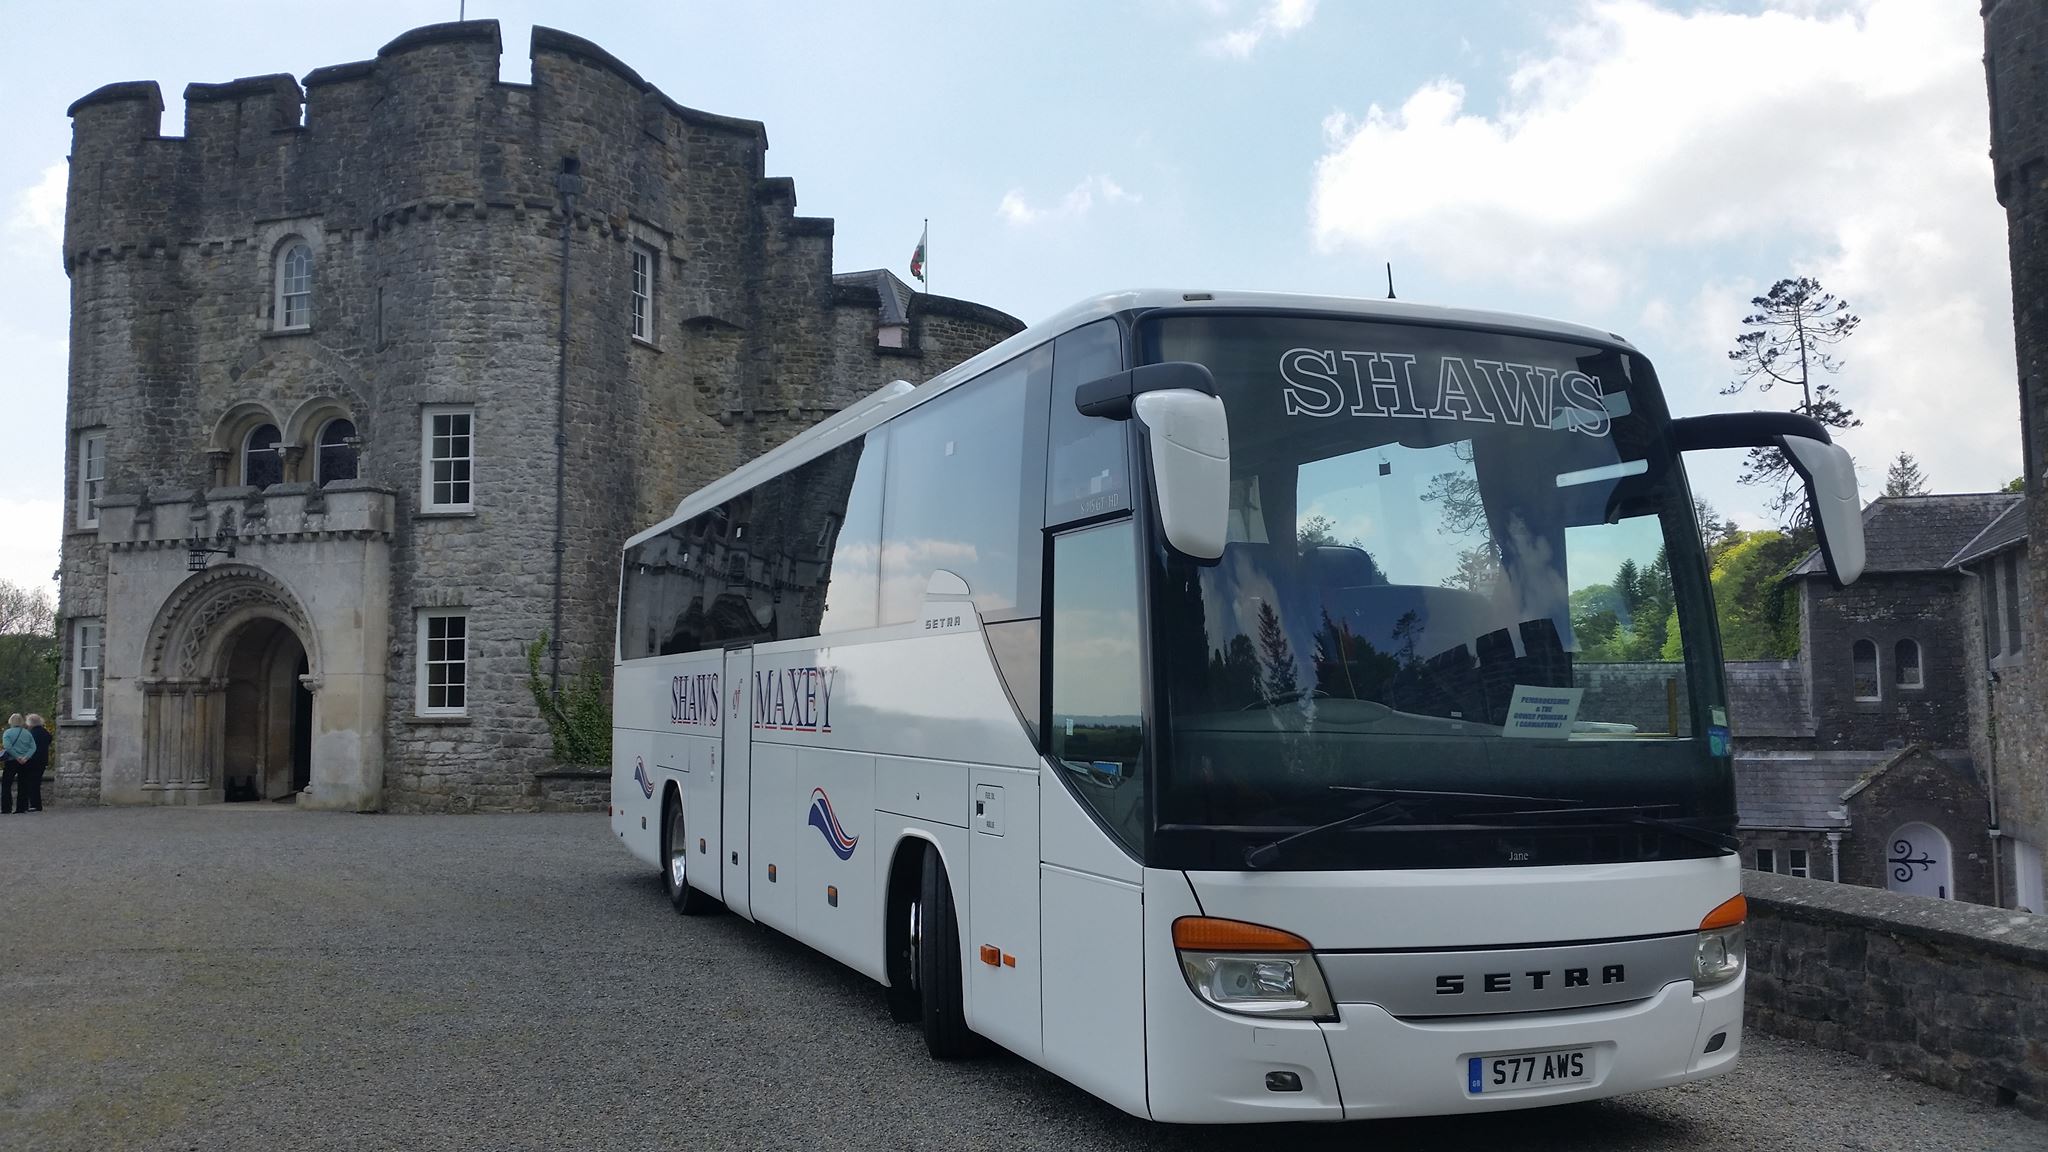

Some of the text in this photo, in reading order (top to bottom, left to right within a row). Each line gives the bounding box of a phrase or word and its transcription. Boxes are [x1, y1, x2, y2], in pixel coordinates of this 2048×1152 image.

[1280, 348, 1611, 437] SHAWS
[925, 616, 961, 630] SETRA
[671, 673, 719, 726] SHAWS
[754, 666, 838, 732] MAXEY
[1509, 851, 1529, 861] Jane
[1436, 964, 1625, 995] SETRA
[1493, 1053, 1584, 1085] S77 AWS
